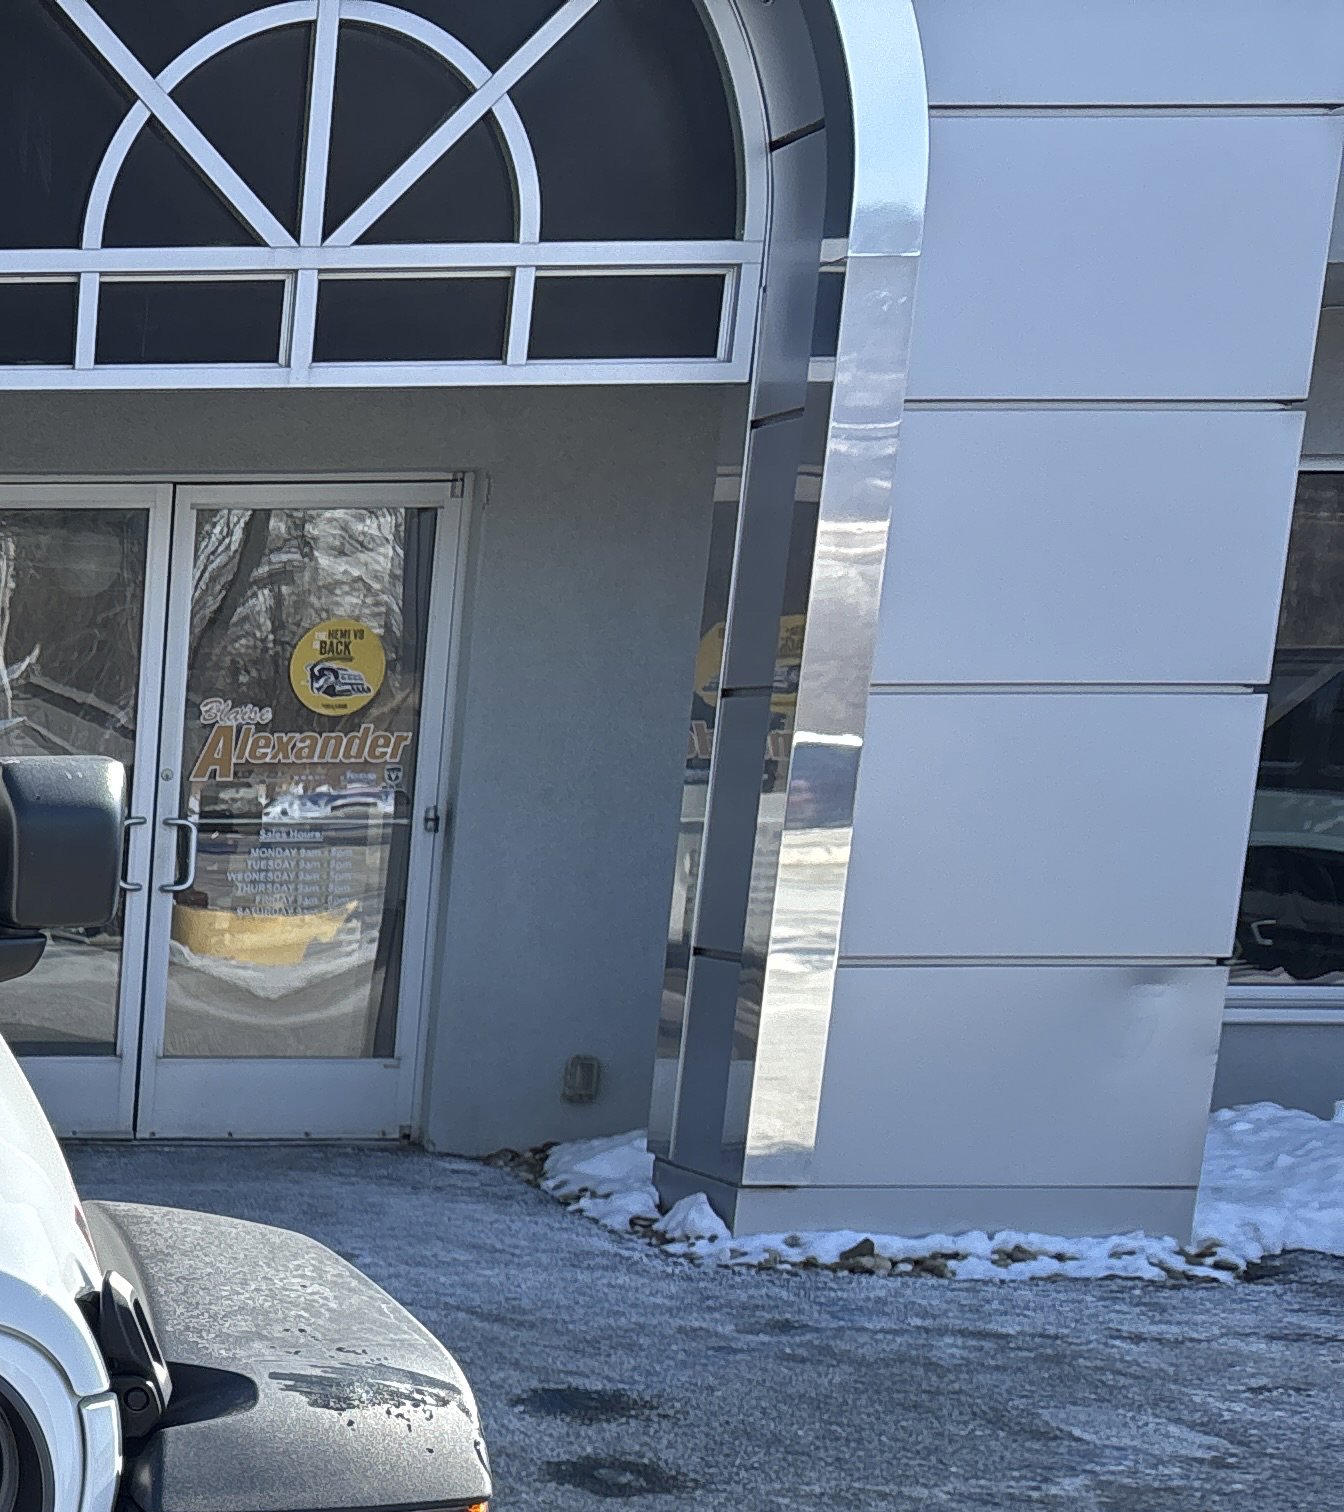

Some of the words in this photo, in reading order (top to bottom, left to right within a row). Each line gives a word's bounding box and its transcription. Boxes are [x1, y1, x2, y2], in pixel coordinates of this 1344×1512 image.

[328, 628, 350, 640] HEMI
[319, 641, 352, 655] BACK
[200, 698, 273, 725] Blaise
[189, 723, 412, 782] Alexander
[259, 829, 288, 840] Sales
[250, 848, 297, 858] MONDAY
[246, 859, 297, 870] TUESDAY
[226, 871, 296, 881] WEDNESDAY
[235, 882, 296, 893] THURSDAY
